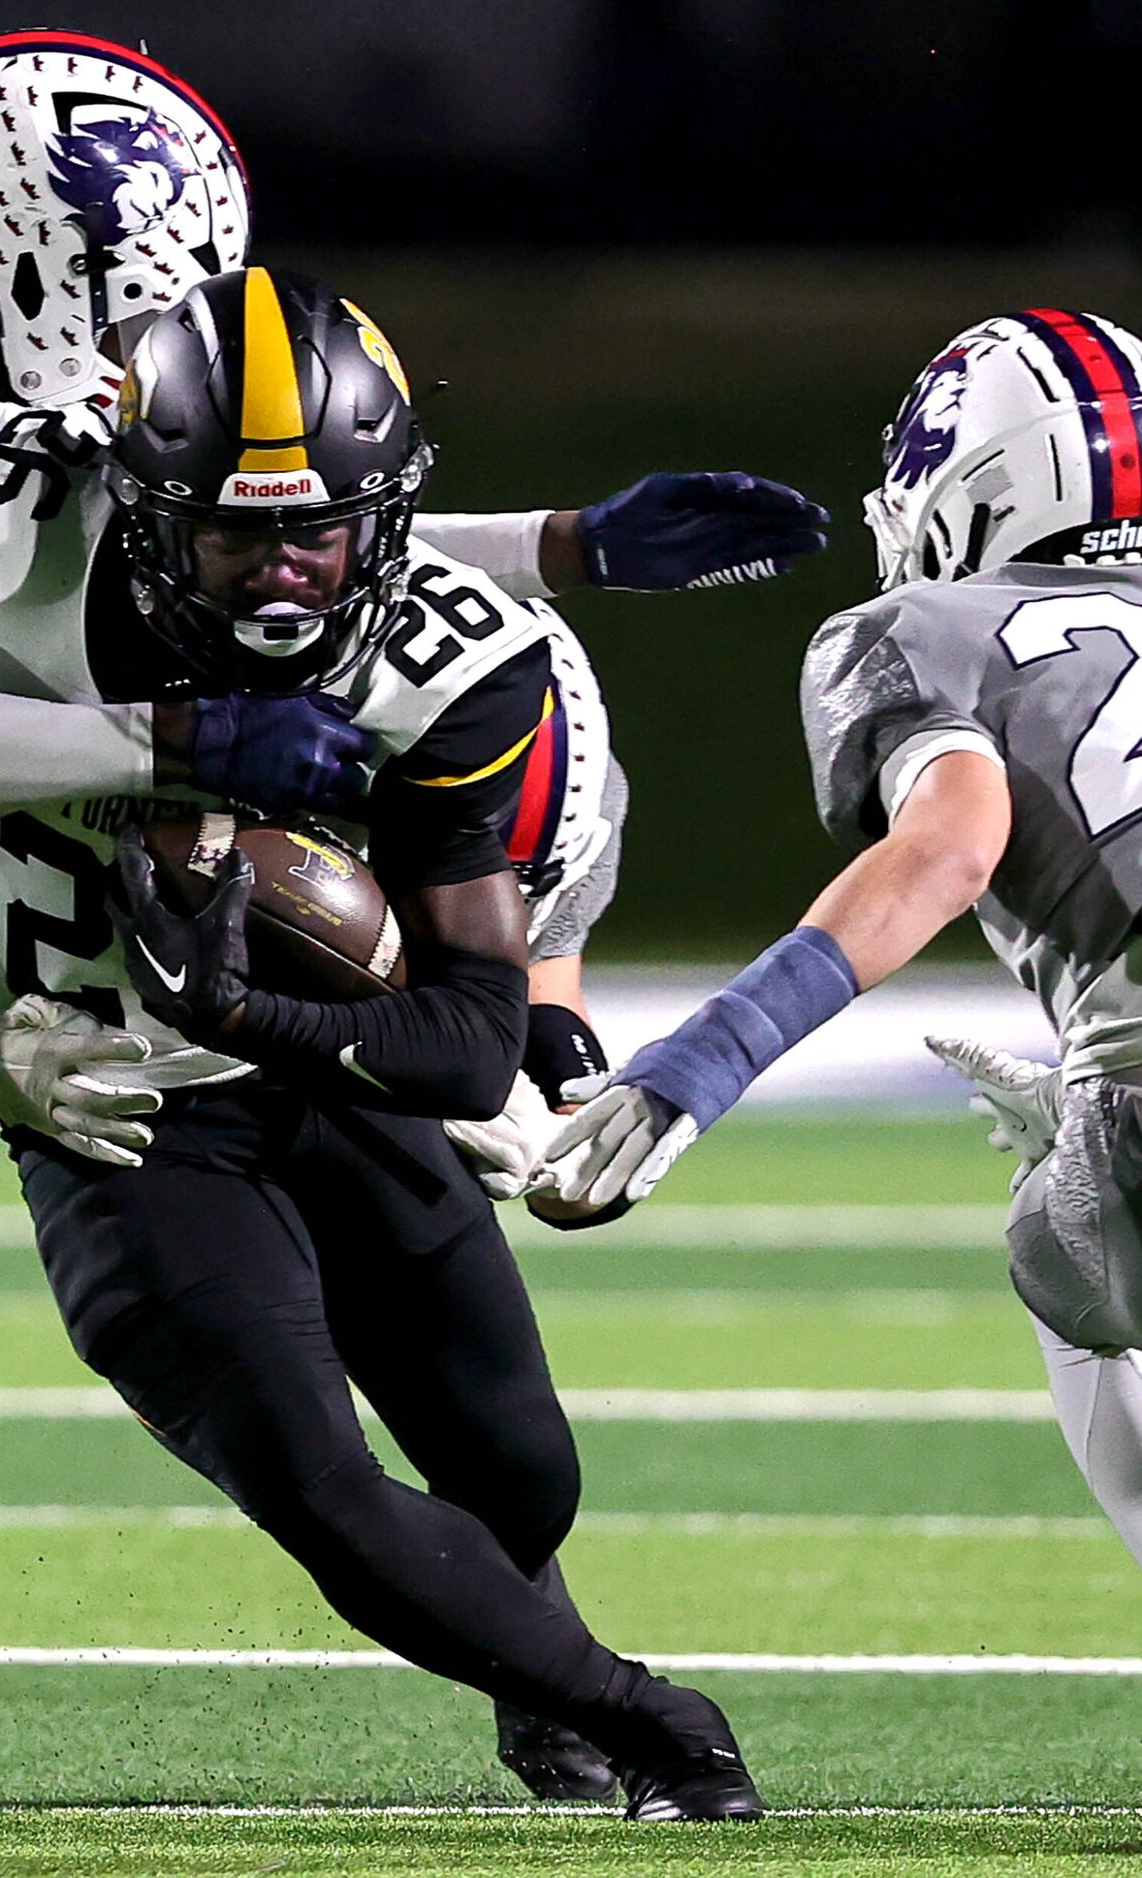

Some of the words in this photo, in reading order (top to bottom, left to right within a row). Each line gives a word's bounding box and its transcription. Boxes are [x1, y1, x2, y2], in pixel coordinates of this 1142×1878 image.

[234, 479, 312, 497] Riddell
[1080, 519, 1142, 553] sch
[385, 563, 505, 689] 26
